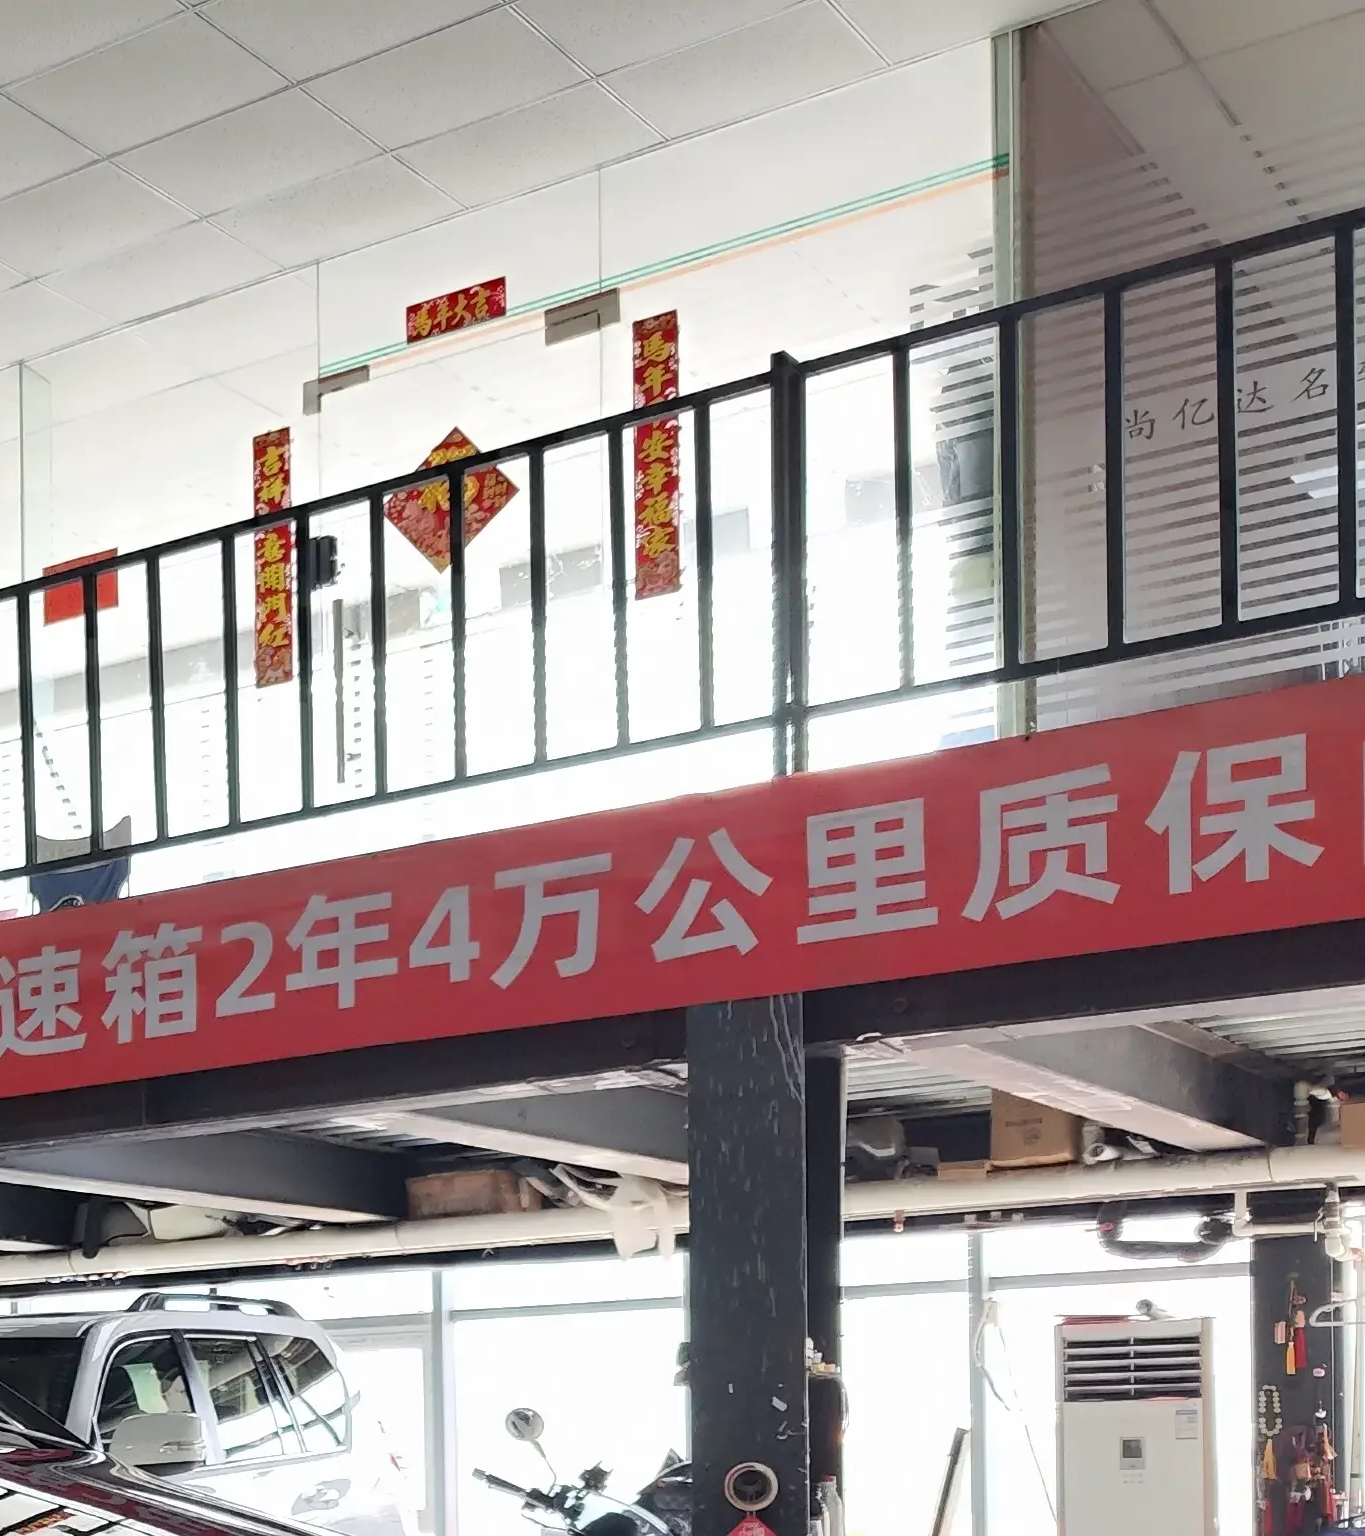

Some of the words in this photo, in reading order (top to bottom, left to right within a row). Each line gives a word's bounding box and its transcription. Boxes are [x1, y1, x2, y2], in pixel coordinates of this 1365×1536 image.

[638, 331, 676, 560] 馬年安幸福家
[1125, 360, 1365, 440] 尚亿达名
